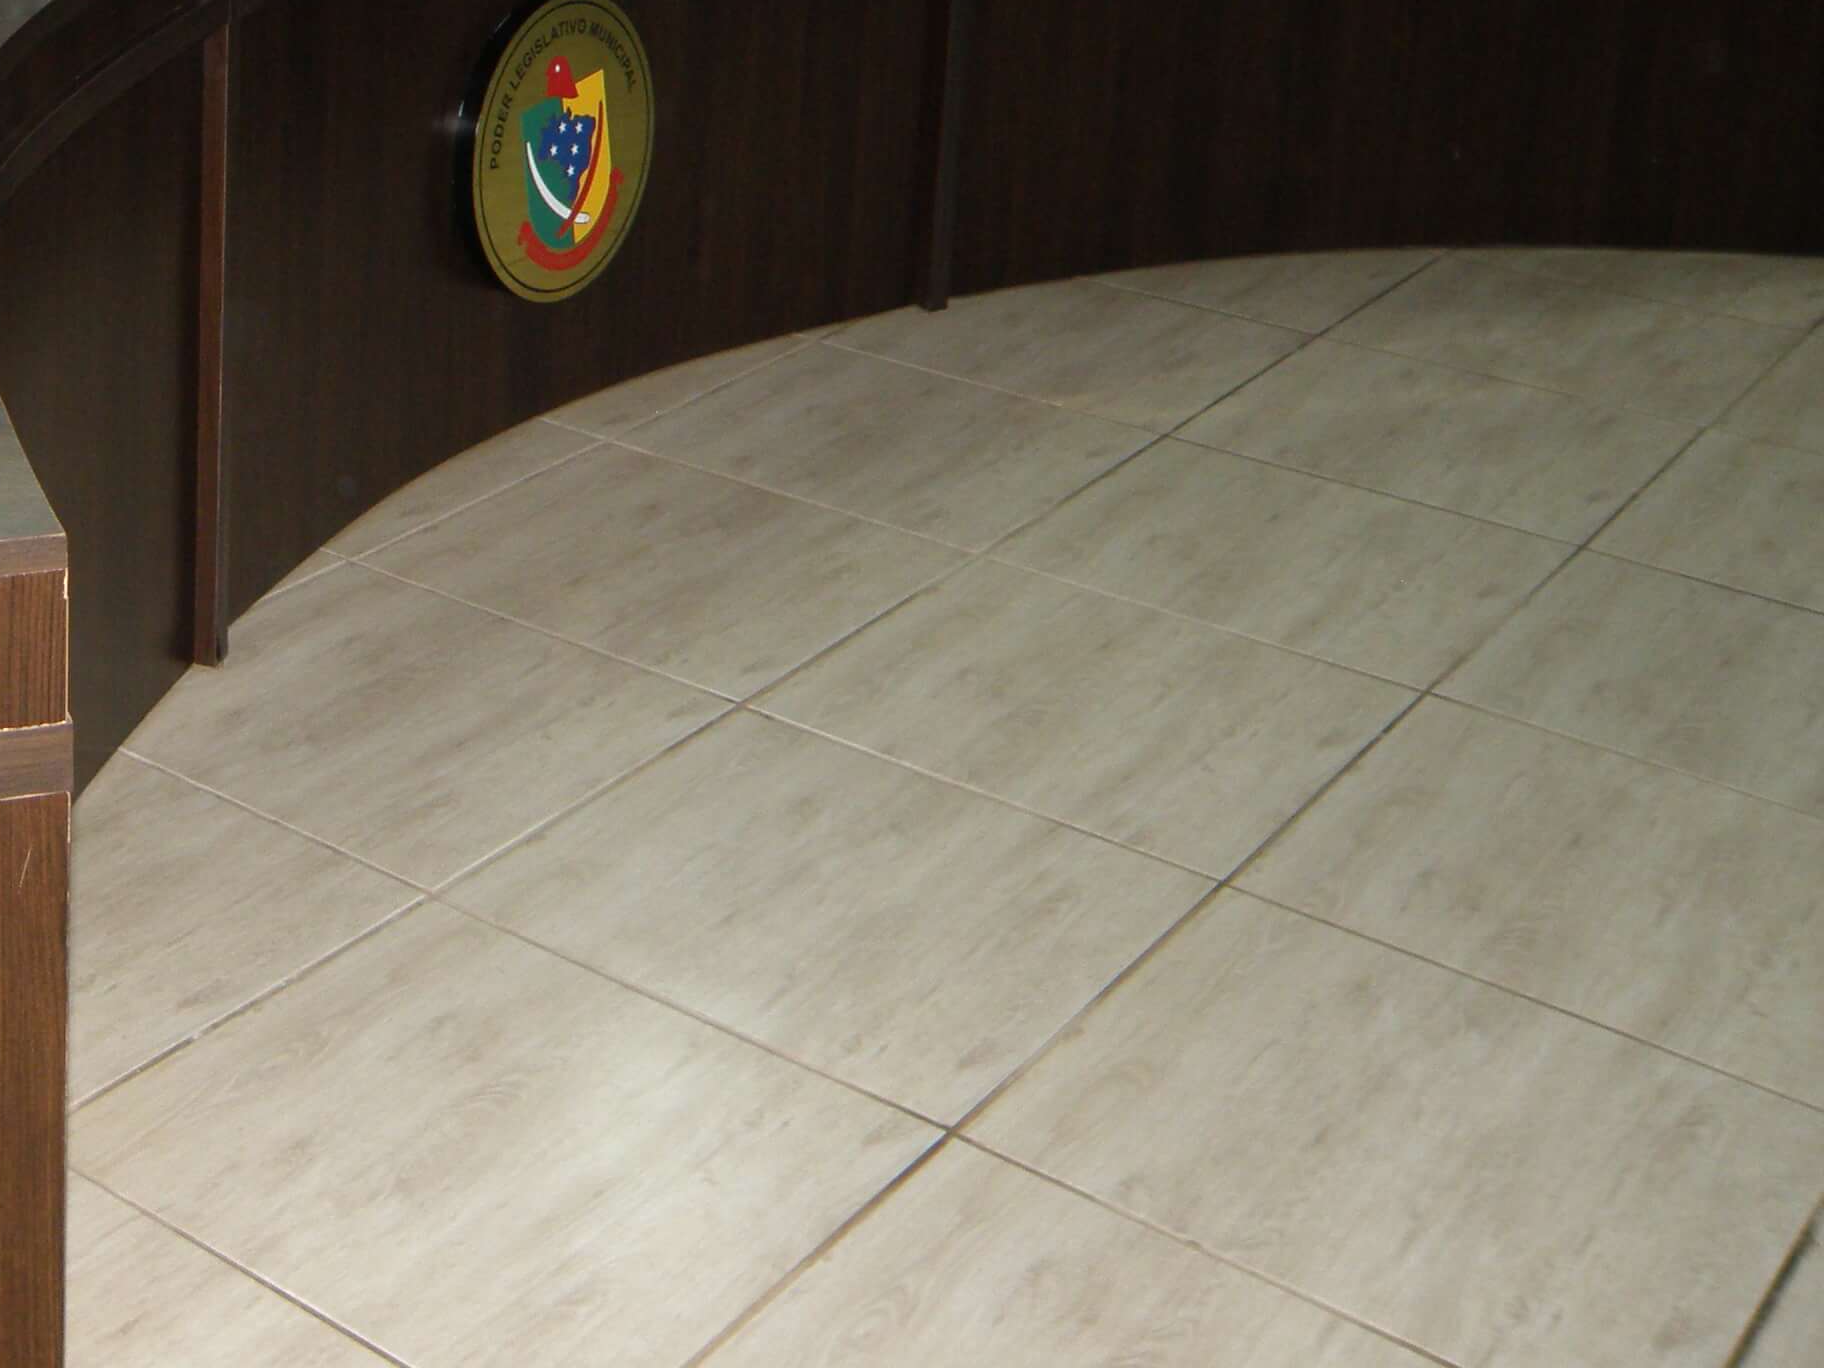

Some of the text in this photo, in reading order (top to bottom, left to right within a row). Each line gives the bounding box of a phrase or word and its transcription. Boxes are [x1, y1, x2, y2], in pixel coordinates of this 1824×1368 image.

[490, 18, 637, 170] PODER LEGISLATIVO MUNICIPAL
